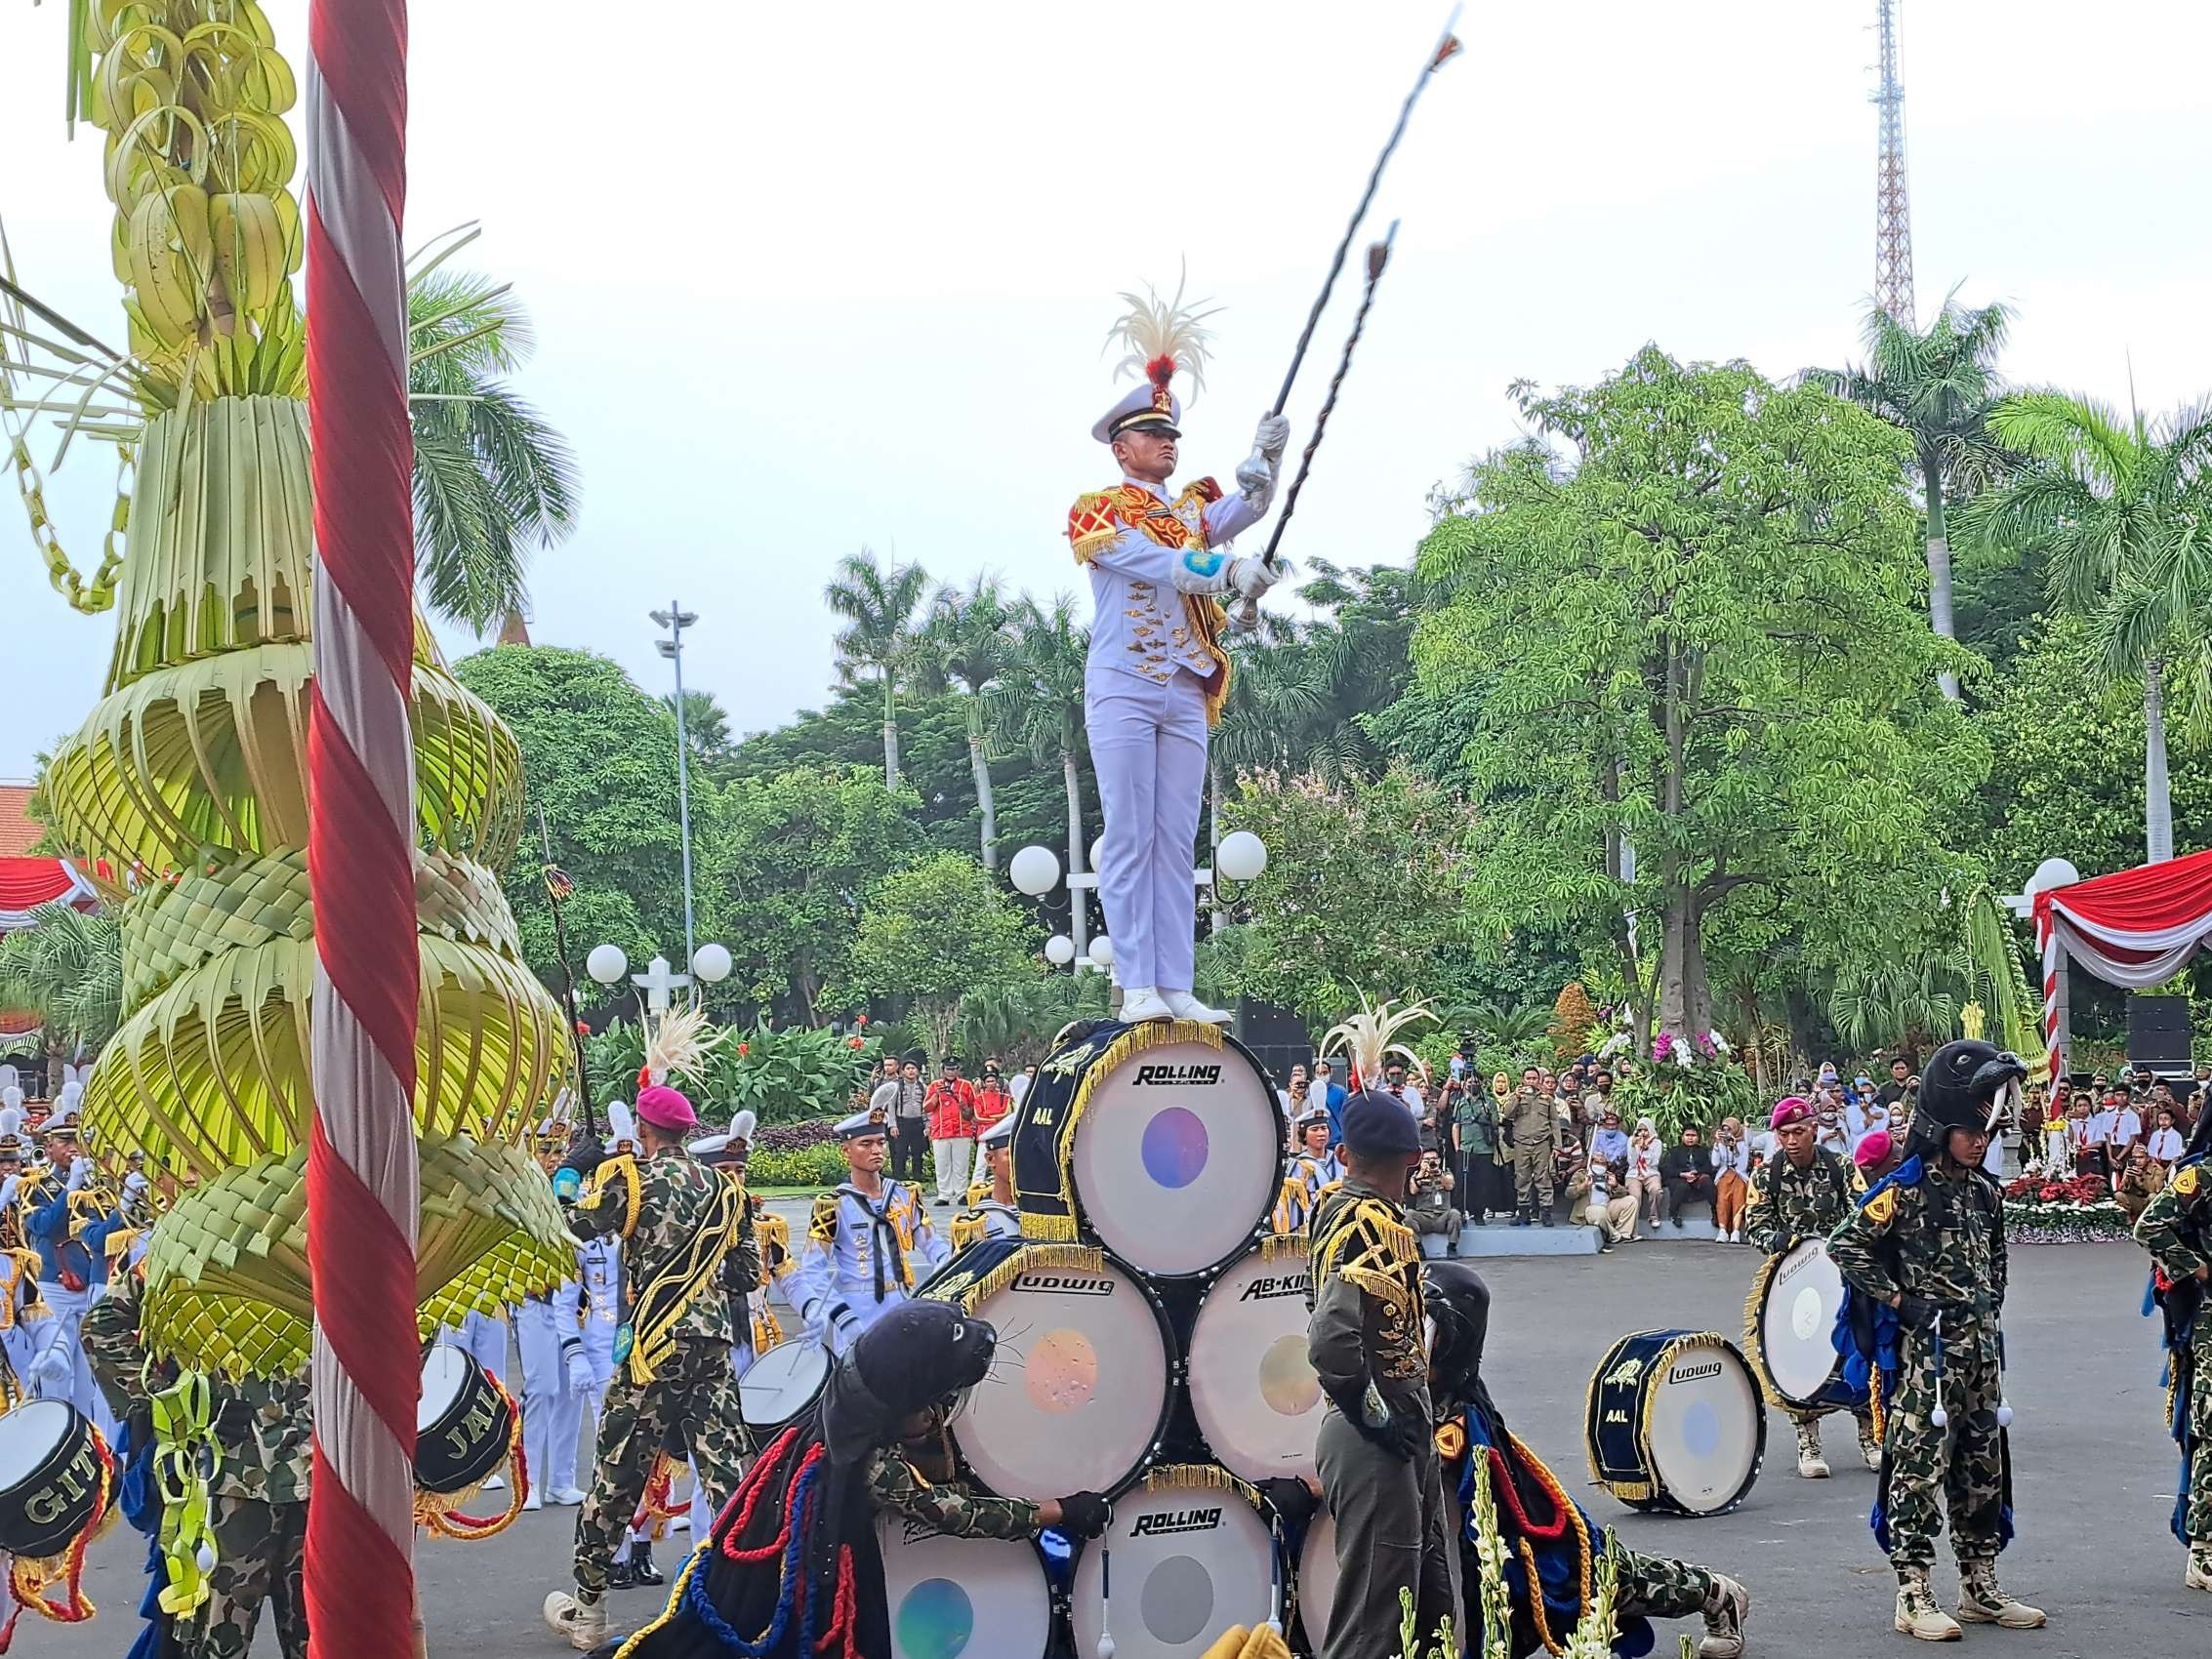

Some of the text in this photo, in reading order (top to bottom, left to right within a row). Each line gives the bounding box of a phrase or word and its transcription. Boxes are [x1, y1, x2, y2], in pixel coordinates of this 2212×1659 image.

[1032, 1107, 1052, 1125] AAL
[1605, 1409, 1628, 1423] AAL
[24, 1423, 97, 1524] GIT
